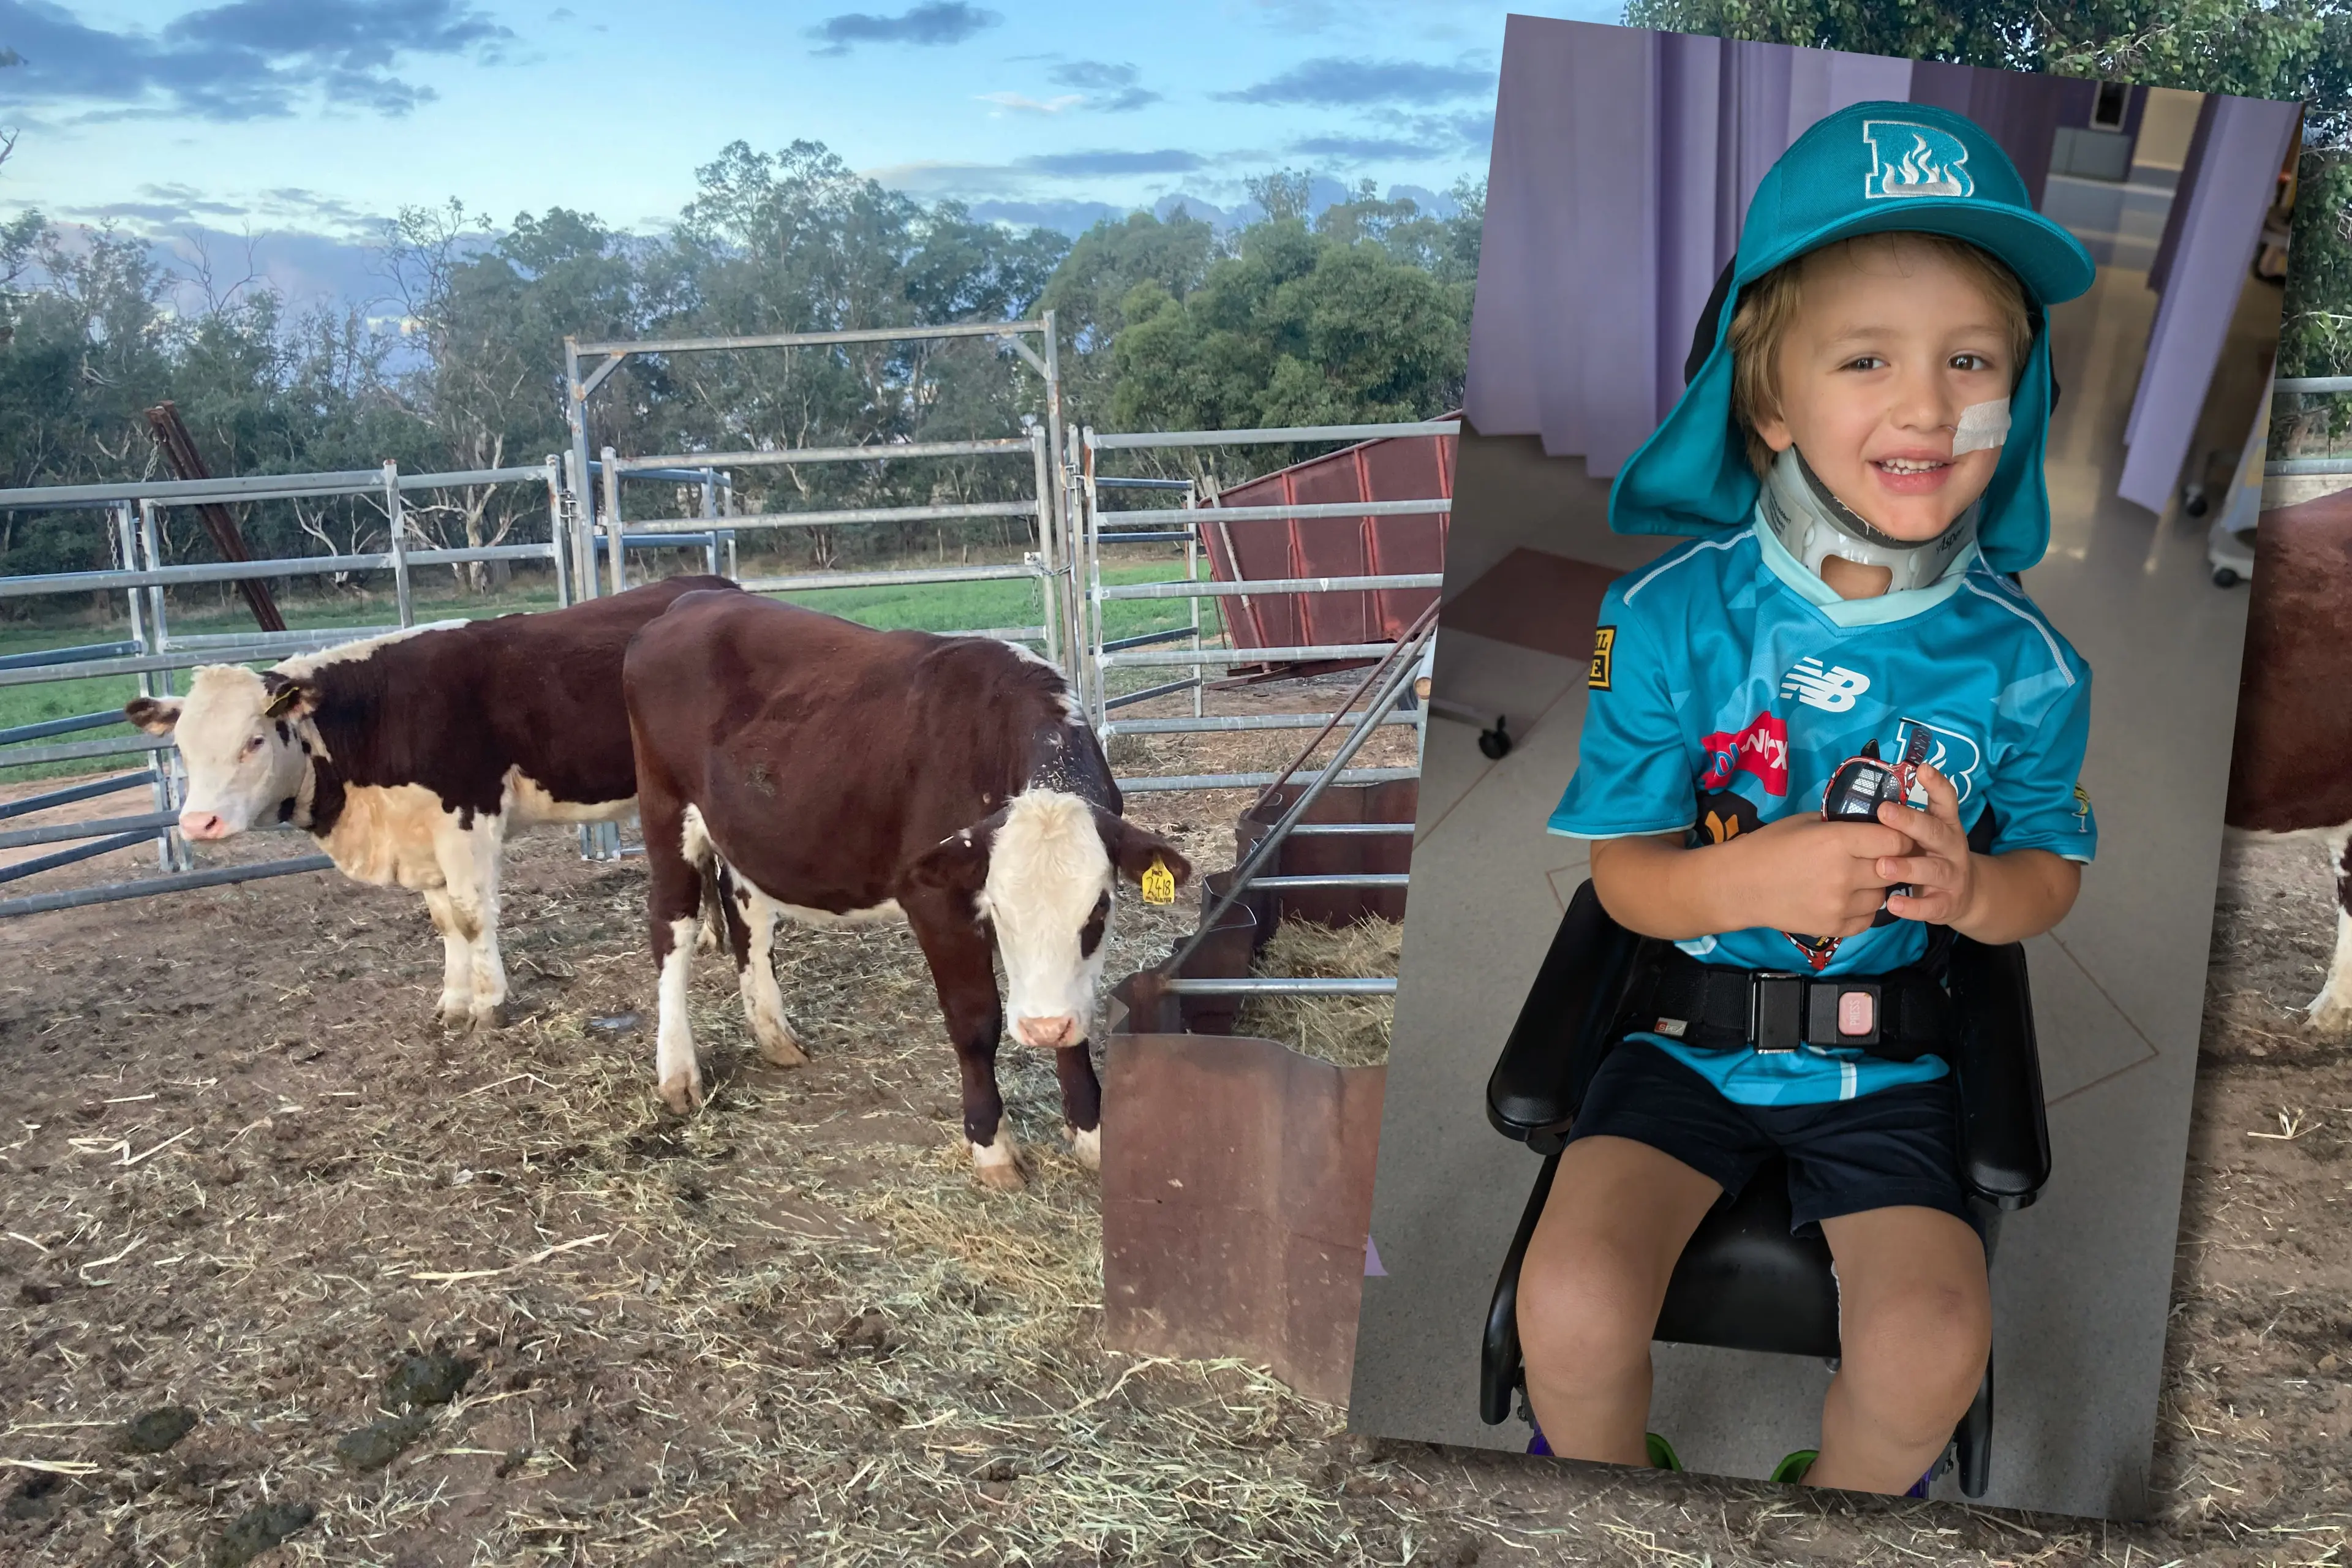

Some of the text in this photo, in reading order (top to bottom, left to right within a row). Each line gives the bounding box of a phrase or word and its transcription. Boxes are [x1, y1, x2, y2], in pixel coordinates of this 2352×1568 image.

[1780, 656, 1871, 712] NB
[1146, 876, 1171, 897] 2418
[1850, 1000, 1860, 1025] PRESS
